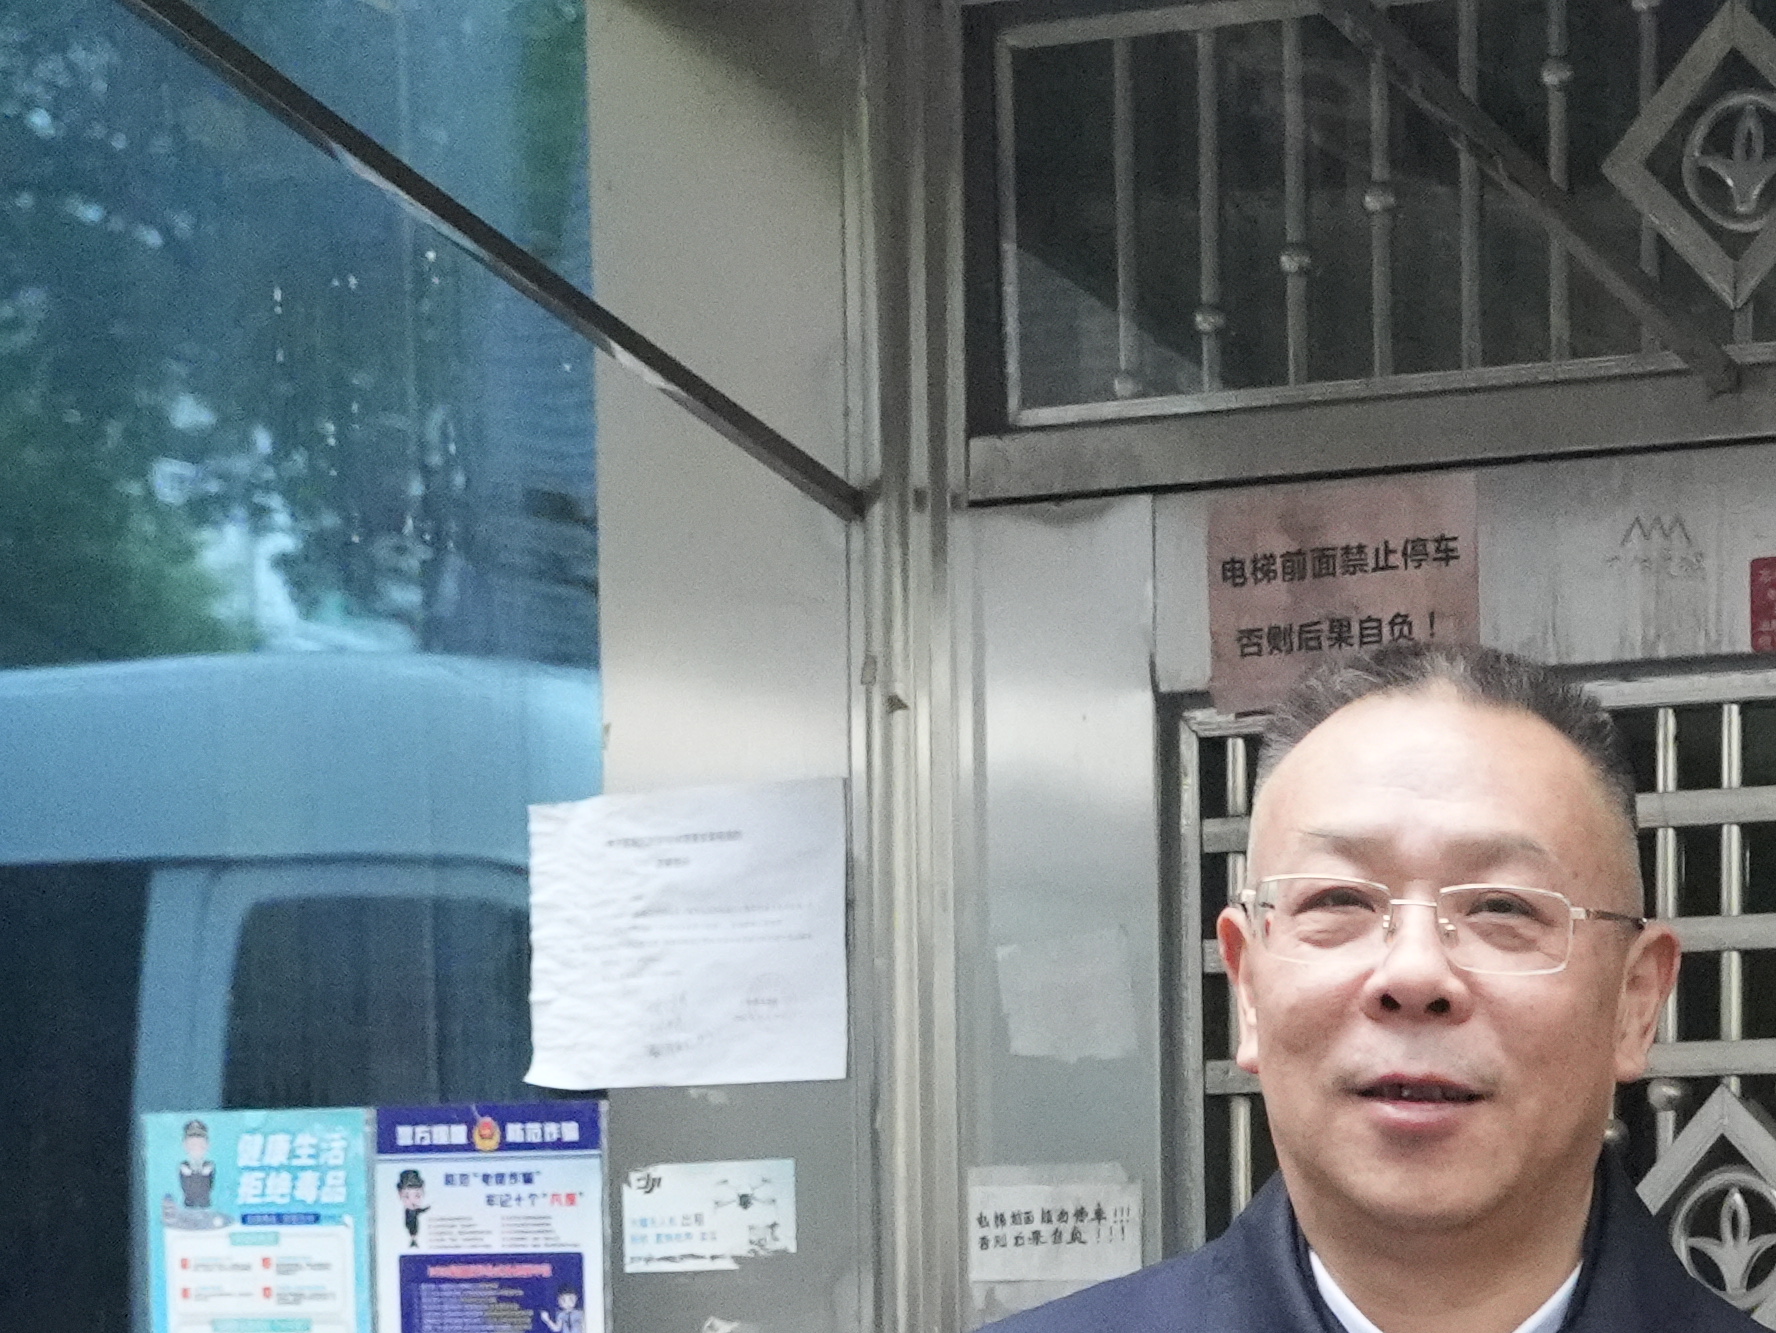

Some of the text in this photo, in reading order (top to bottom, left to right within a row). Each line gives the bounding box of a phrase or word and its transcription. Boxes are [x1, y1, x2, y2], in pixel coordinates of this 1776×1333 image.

[1221, 533, 1460, 587] 电梯前面禁止停车
[1236, 611, 1435, 658] 否则后果自负！
